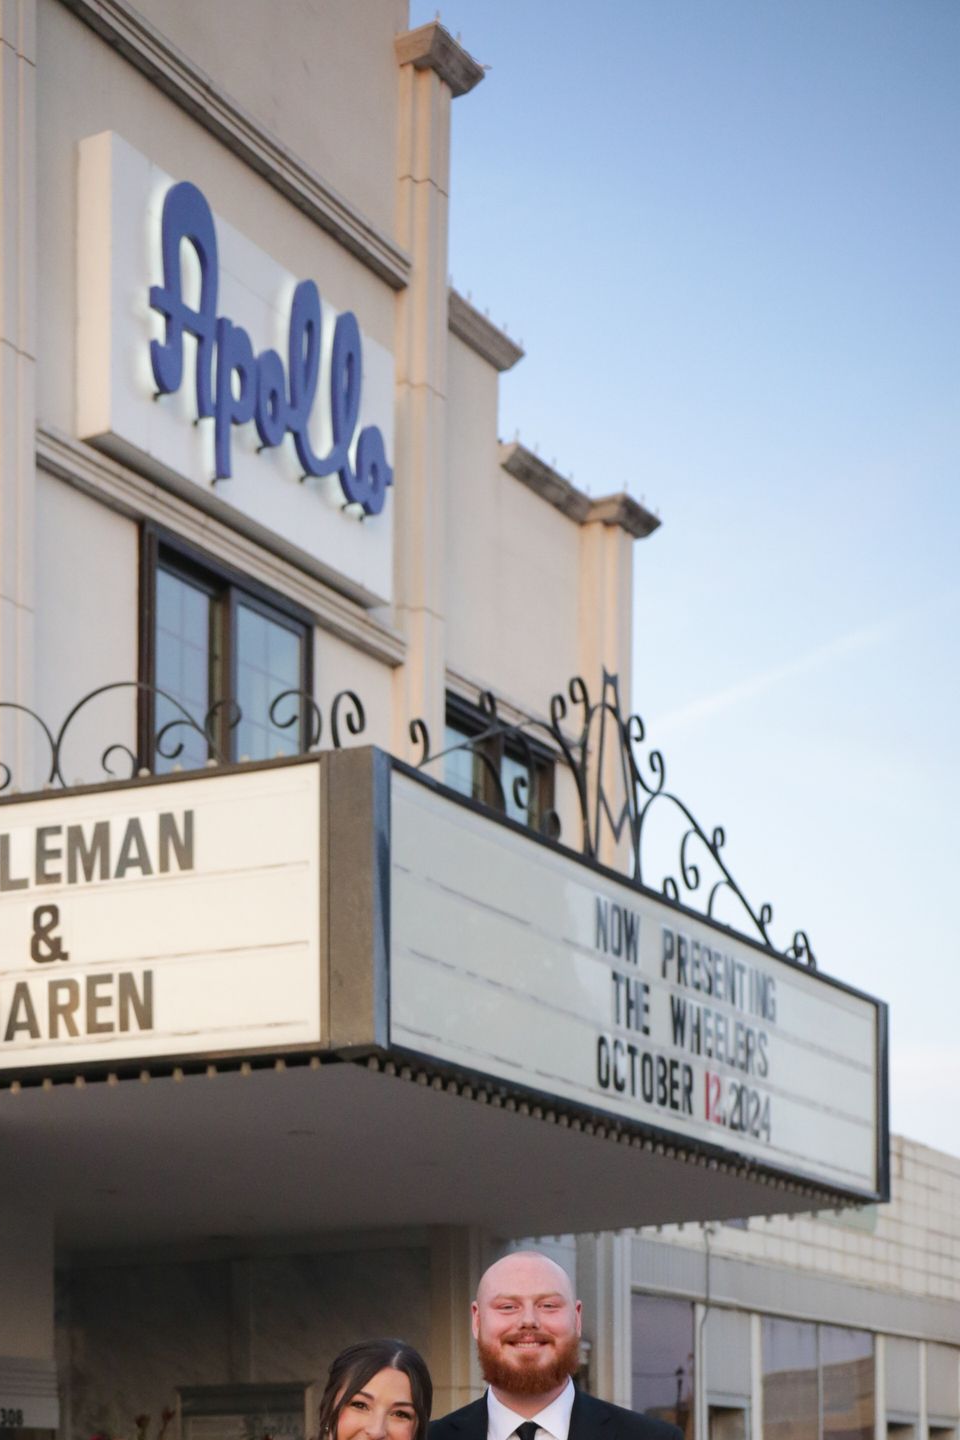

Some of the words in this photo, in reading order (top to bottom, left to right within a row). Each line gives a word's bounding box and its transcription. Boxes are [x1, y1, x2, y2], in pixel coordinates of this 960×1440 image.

[149, 181, 393, 516] Apollo
[30, 903, 69, 963] &
[595, 897, 640, 965] NOW
[661, 927, 776, 1022] PRESENTING
[596, 1035, 694, 1115] OCTOBER
[612, 970, 651, 1036] THE
[670, 994, 769, 1078] WHEELERS
